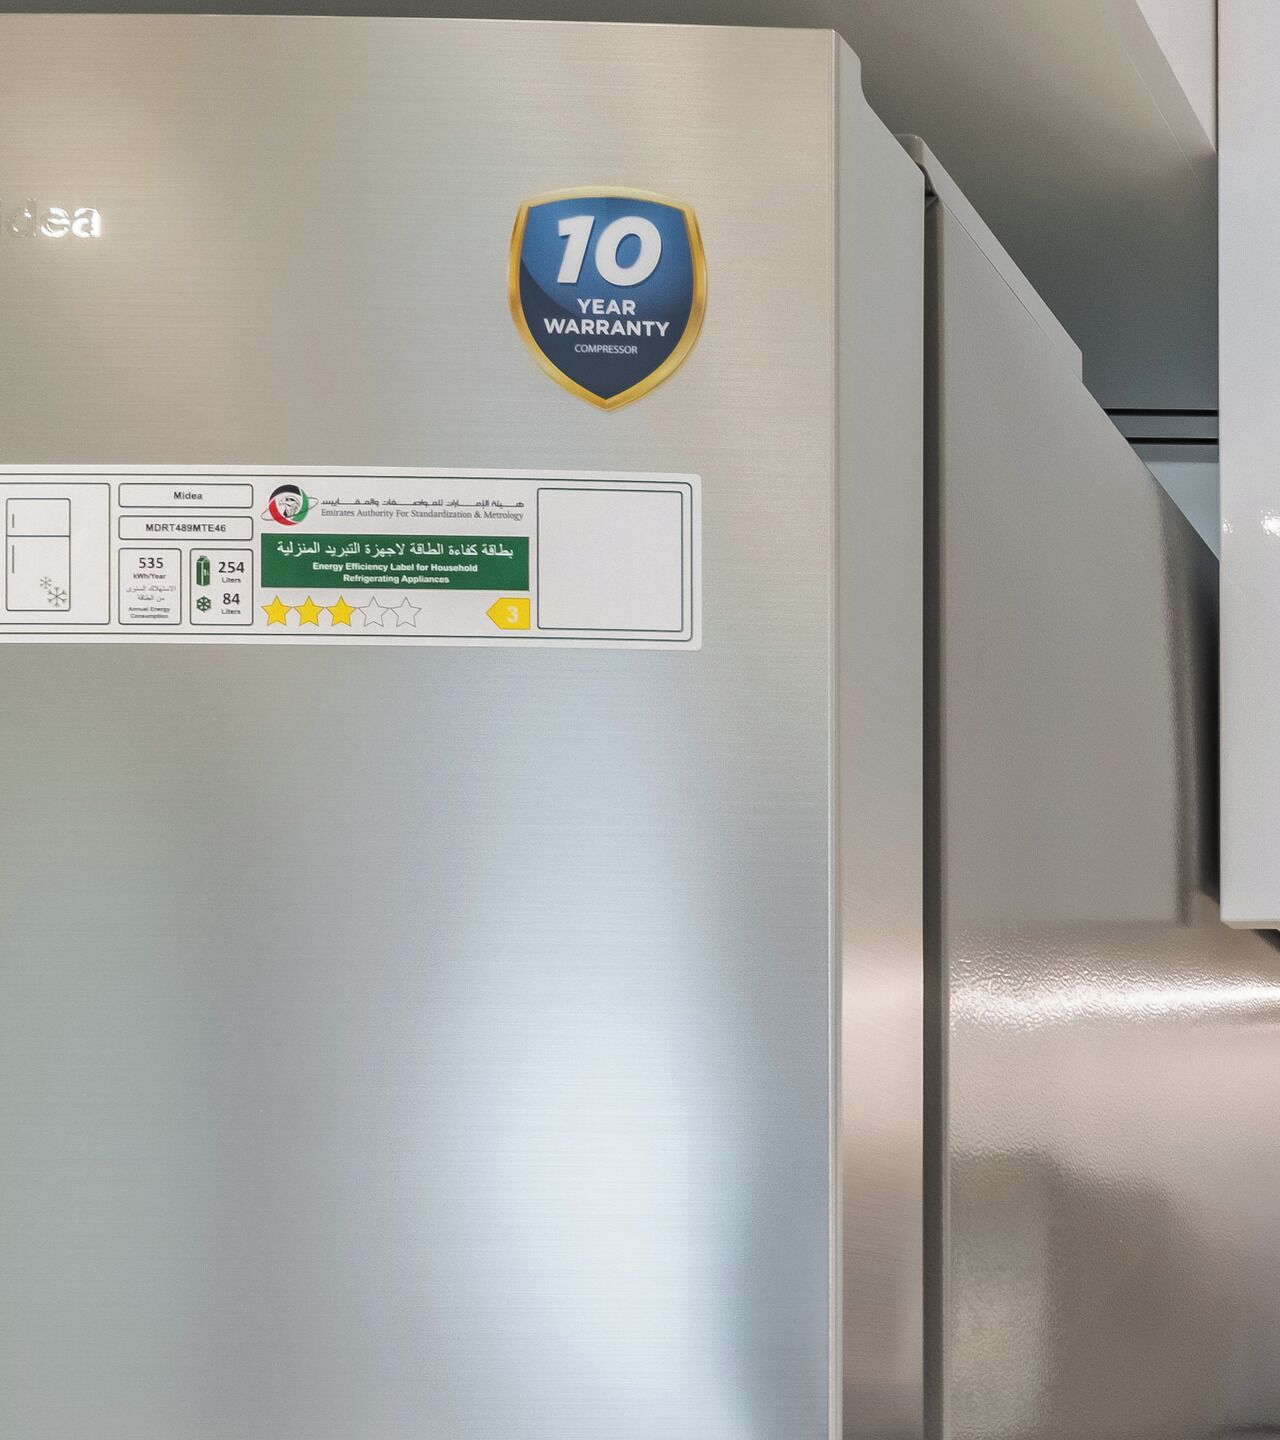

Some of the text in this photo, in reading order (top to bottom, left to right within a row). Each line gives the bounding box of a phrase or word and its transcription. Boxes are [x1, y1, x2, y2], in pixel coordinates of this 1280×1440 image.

[557, 215, 662, 287] 10
[577, 298, 636, 316] YEAR
[543, 317, 670, 337] WARRANTY
[574, 343, 638, 355] COMPRESSOR
[173, 491, 203, 500] Midea
[321, 509, 524, 521] Emirates Authority For Standardization & Metrology
[145, 523, 227, 533] MDRT489MTE46
[277, 541, 320, 557] المنزلية
[325, 541, 360, 558] التبريد
[409, 542, 444, 556] الطاقة
[448, 543, 479, 557] كفاءة
[481, 543, 514, 559] بطاقة
[138, 557, 164, 569] 535
[218, 561, 245, 574] 254
[312, 562, 478, 573] Energy Efficiency Label for Household
[132, 573, 167, 581] kWh/Year
[343, 574, 450, 585] Refrigerating Appliances
[222, 593, 241, 605] 84
[506, 606, 519, 623] 3
